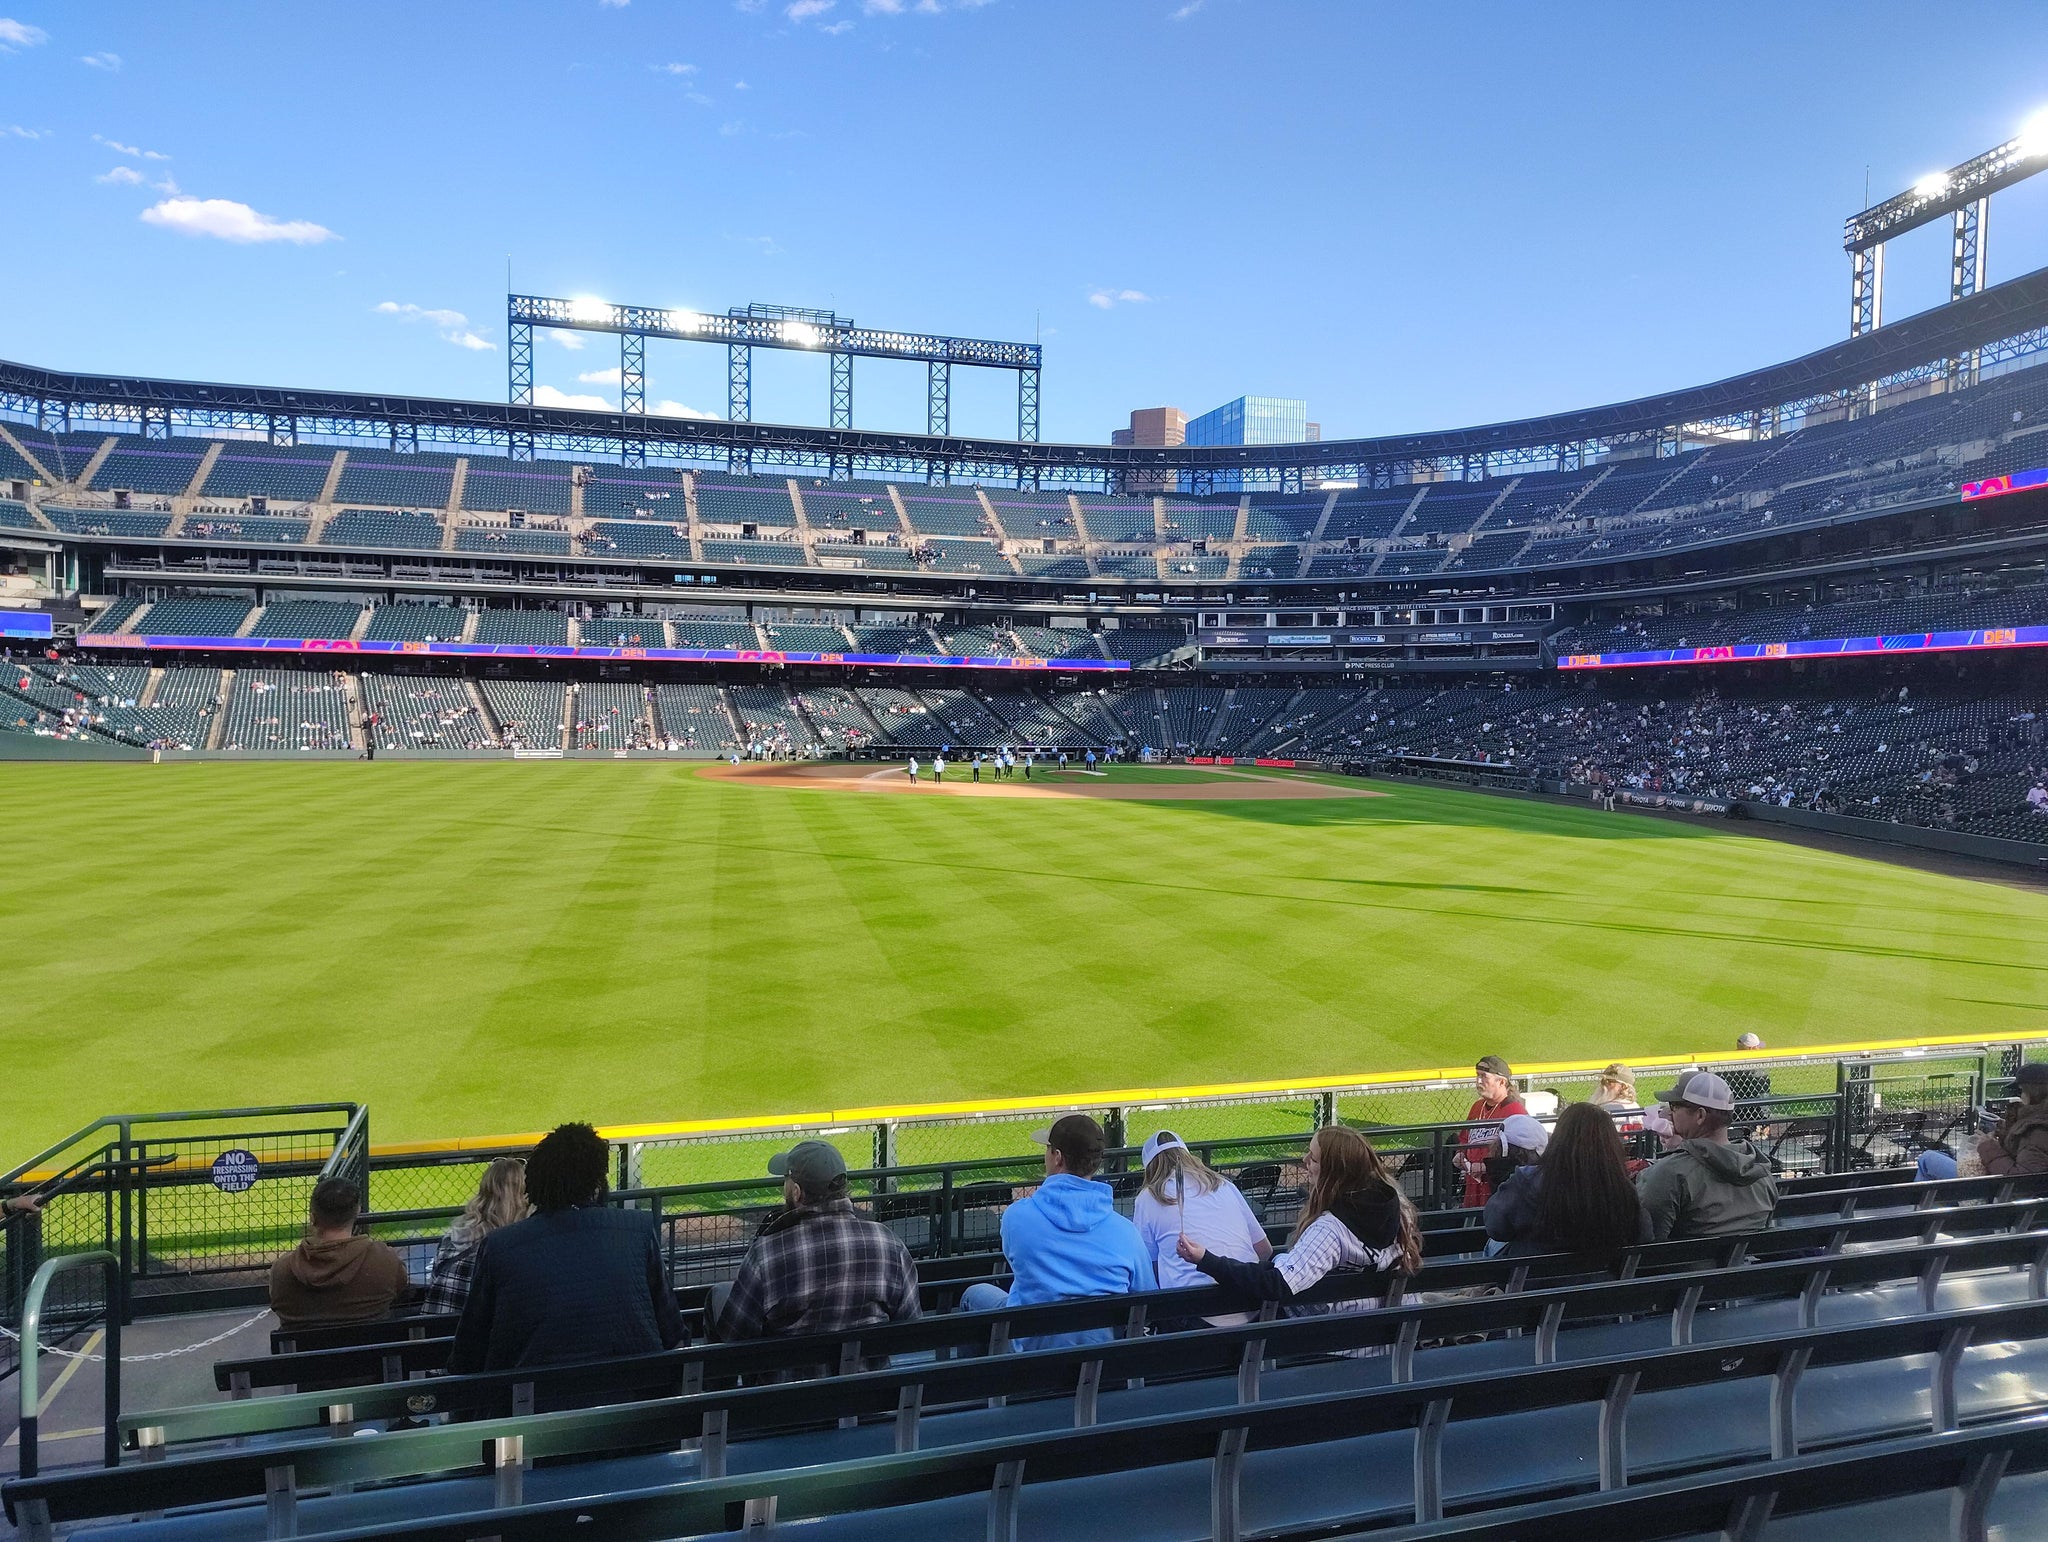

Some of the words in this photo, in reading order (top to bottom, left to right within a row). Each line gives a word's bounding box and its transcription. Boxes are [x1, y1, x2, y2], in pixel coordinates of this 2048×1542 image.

[1984, 629, 2016, 644] DEN
[403, 642, 430, 651] DEN
[1766, 642, 1787, 656] DEN
[621, 649, 647, 657] DEN
[821, 653, 844, 662] DEN
[1631, 795, 1649, 804] TOYOTA
[1666, 799, 1686, 808] TOYOTA
[1703, 803, 1725, 813] TOYOTA
[225, 1152, 246, 1165] NO
[212, 1164, 258, 1175] TRESPASSING
[214, 1174, 238, 1183] ONTO
[240, 1173, 256, 1181] THE
[222, 1182, 248, 1191] FIELD
